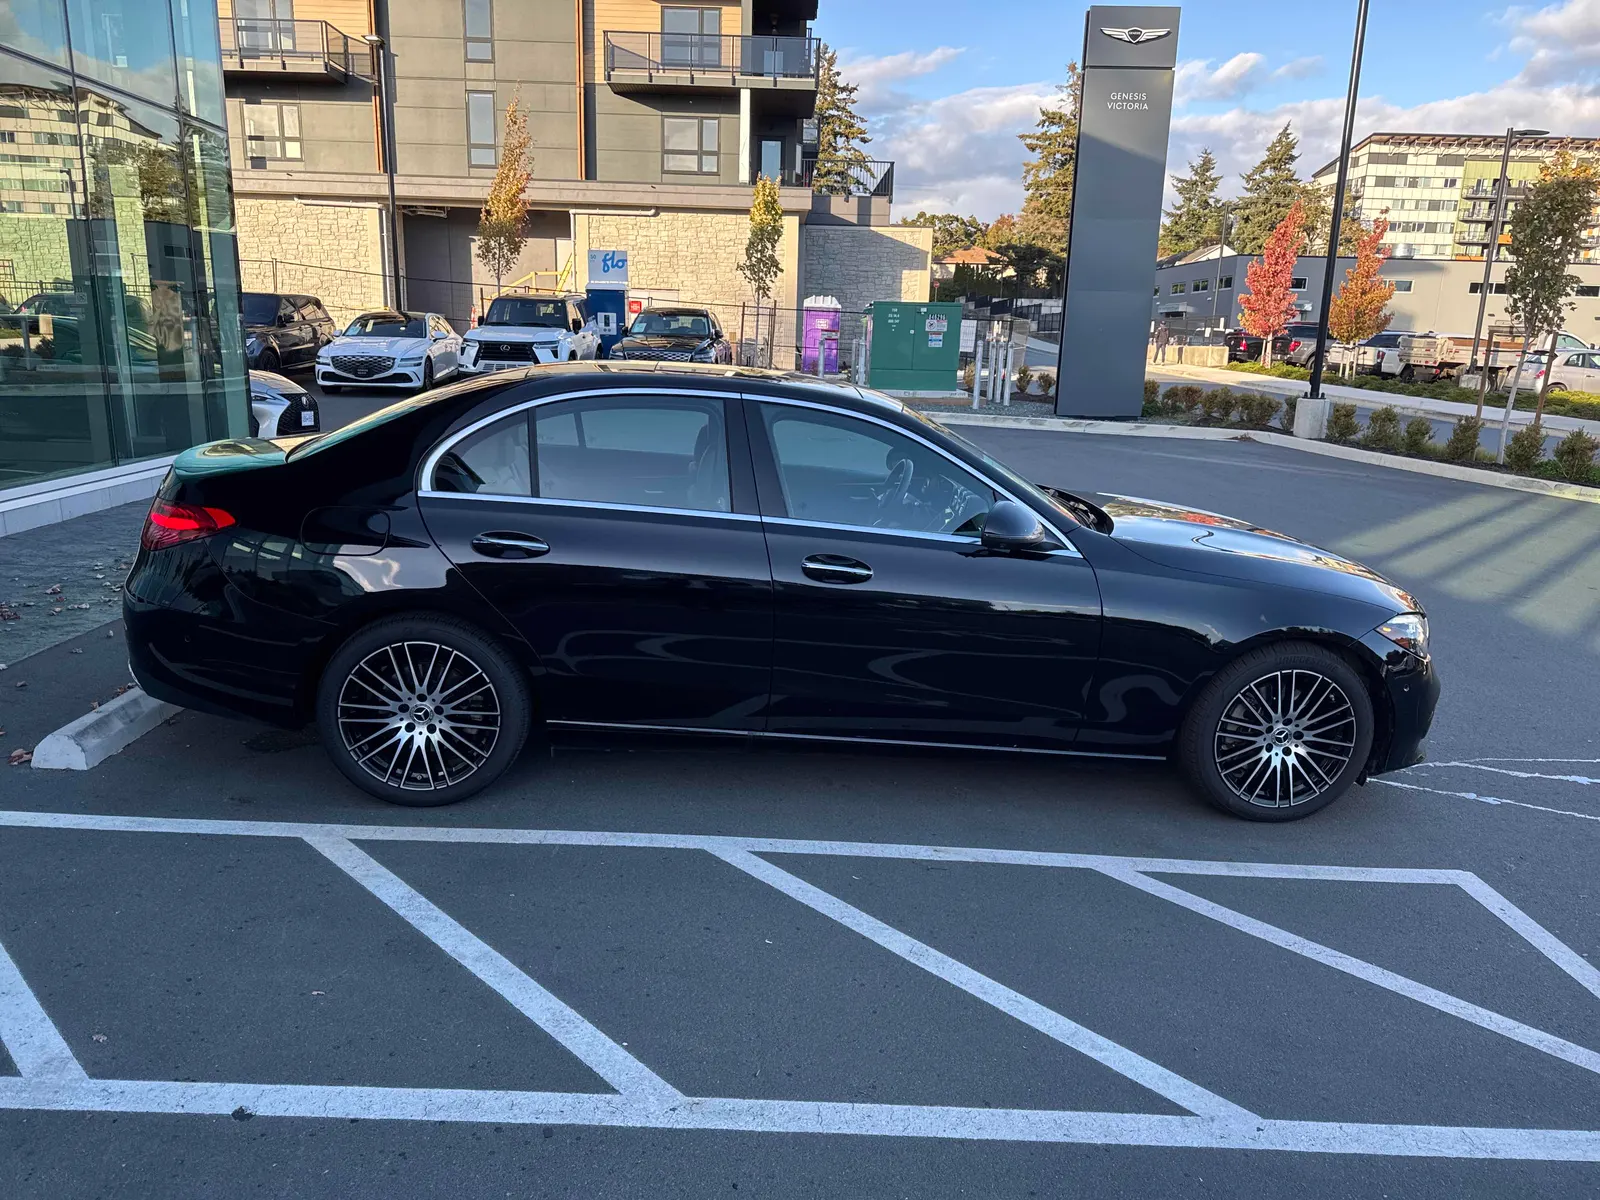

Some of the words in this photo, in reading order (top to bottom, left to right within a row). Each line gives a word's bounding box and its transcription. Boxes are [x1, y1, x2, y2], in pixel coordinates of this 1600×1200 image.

[1110, 92, 1147, 101] GENESIS
[1107, 102, 1149, 110] VICTORIA
[602, 250, 627, 273] flo
